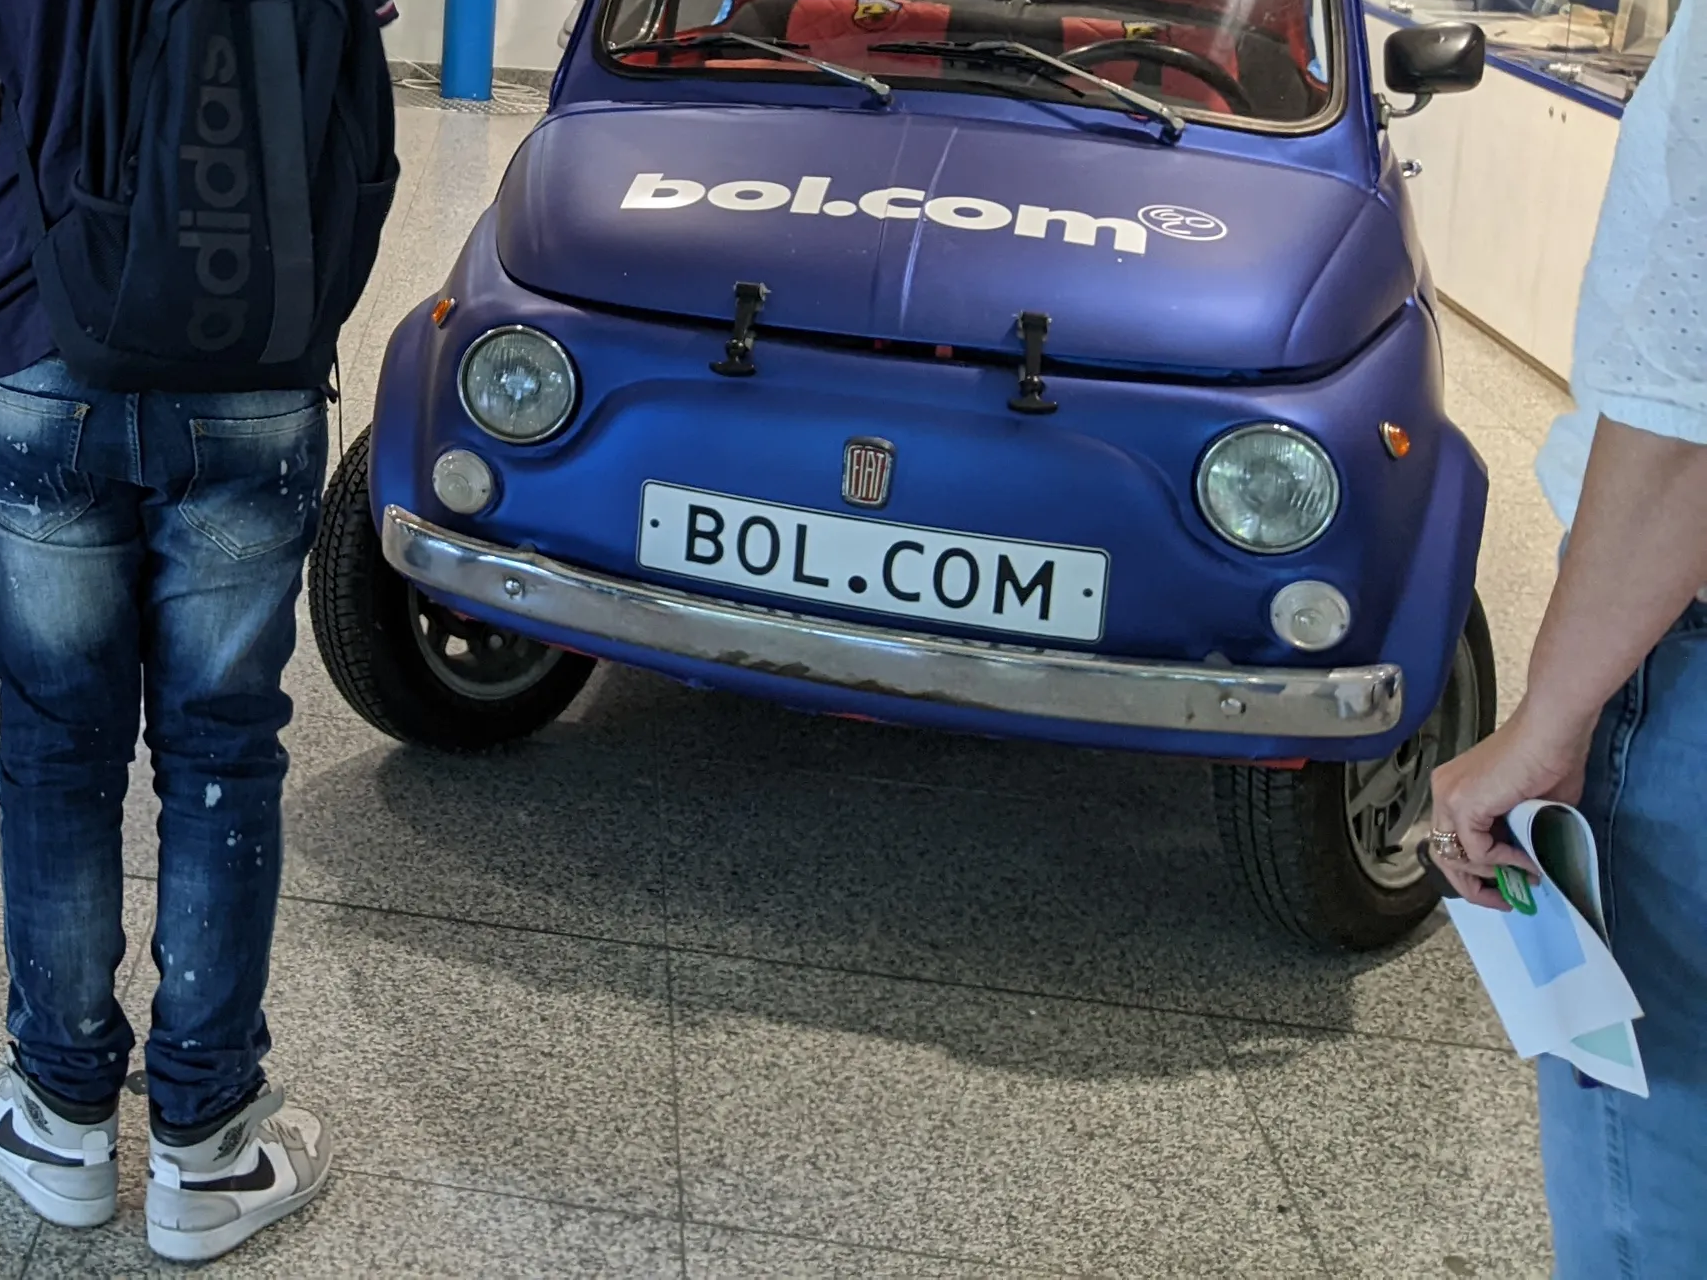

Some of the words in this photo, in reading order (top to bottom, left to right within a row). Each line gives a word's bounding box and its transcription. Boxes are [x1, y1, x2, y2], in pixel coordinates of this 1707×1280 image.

[179, 34, 252, 352] adidas
[619, 172, 1149, 256] bol.com
[850, 449, 885, 499] FIAT
[684, 503, 1056, 621] BOL.COM
